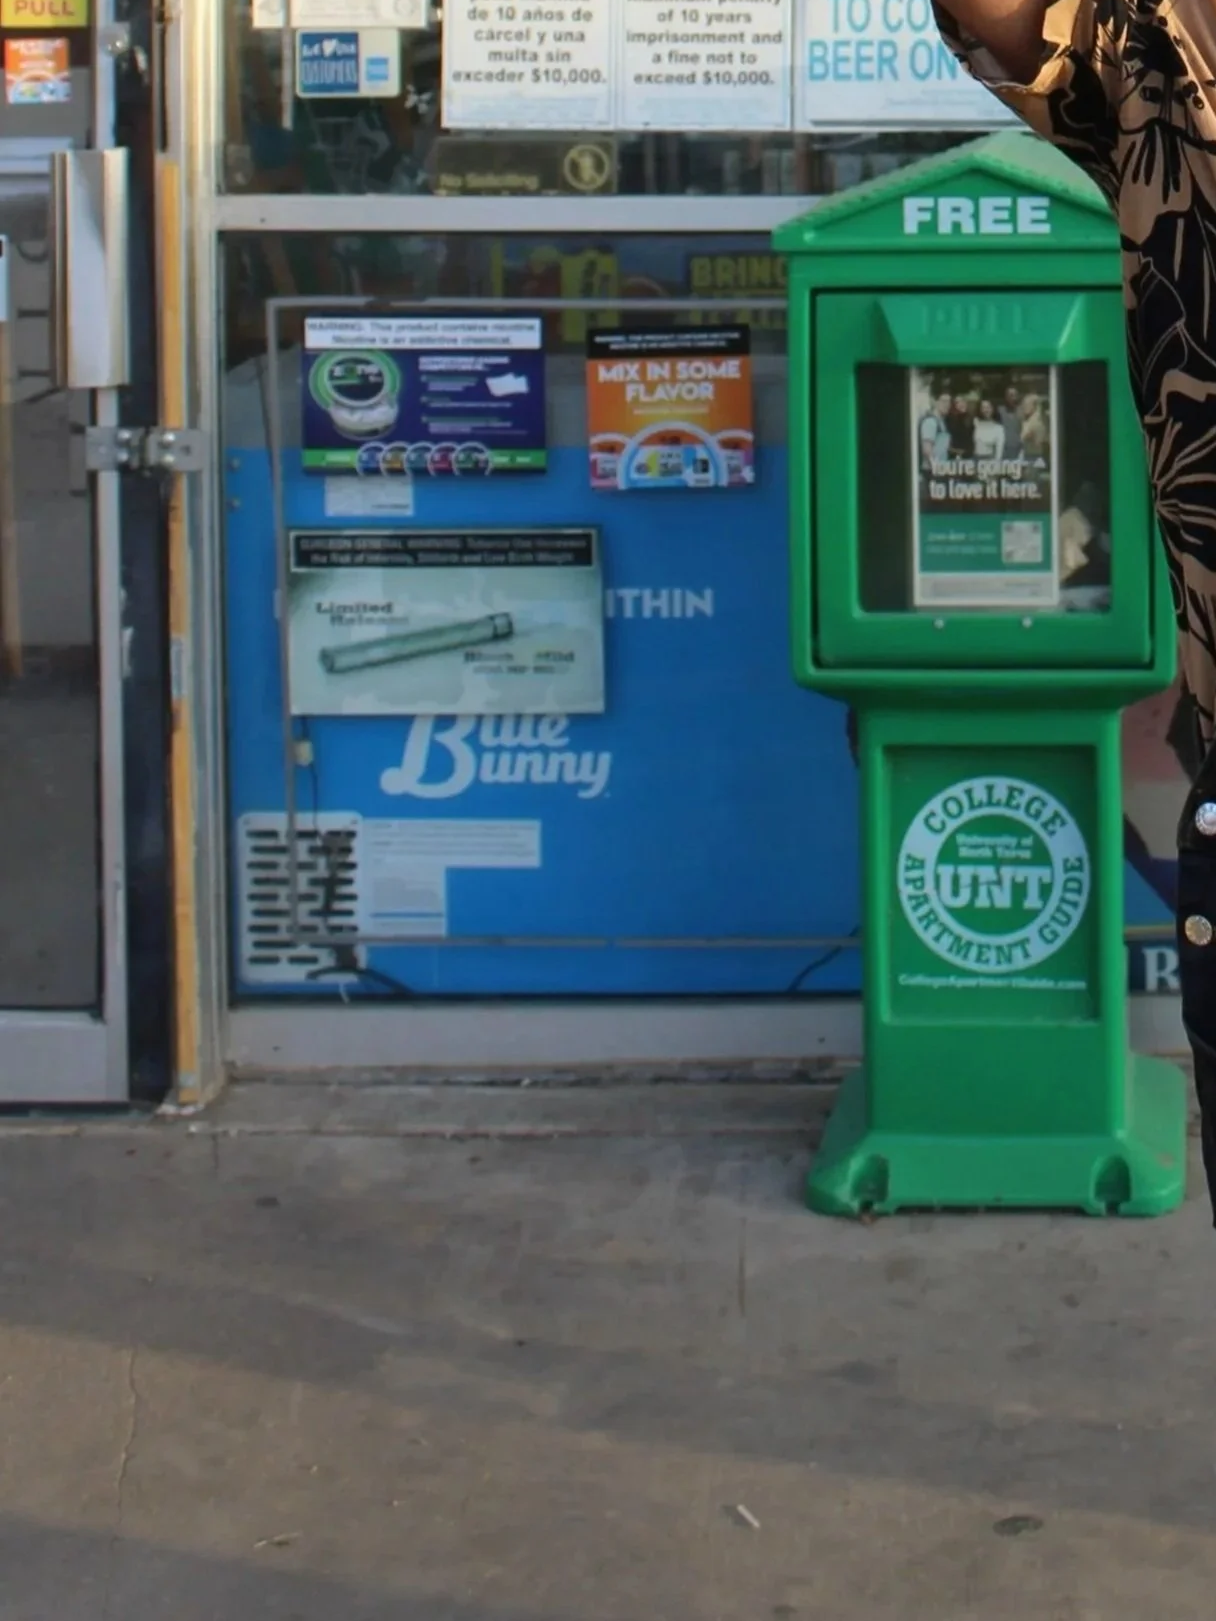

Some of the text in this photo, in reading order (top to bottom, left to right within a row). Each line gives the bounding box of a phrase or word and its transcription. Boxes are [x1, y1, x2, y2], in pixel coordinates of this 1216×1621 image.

[13, 0, 75, 17] PULL
[467, 6, 593, 22] de 10 años de
[657, 9, 752, 26] of 10 years
[474, 28, 585, 46] cárcel y una
[626, 30, 782, 46] imprisonment and
[488, 48, 572, 62] multa sin
[652, 50, 757, 65] a fine not to
[807, 40, 899, 81] BEER
[452, 67, 606, 86] exceder $10,000.
[634, 70, 774, 88] exceed $10,000.
[903, 196, 1052, 235] FREE
[598, 359, 742, 383] MIX IN SOME
[625, 382, 715, 403] FLAVOR
[930, 457, 1022, 480] You're going
[929, 479, 1042, 499] to love it here.
[316, 601, 393, 615] Limited
[923, 784, 1068, 836] COLLEGE
[936, 865, 1053, 909] UNT
[904, 854, 1084, 965] APARTMENT GUIDE
